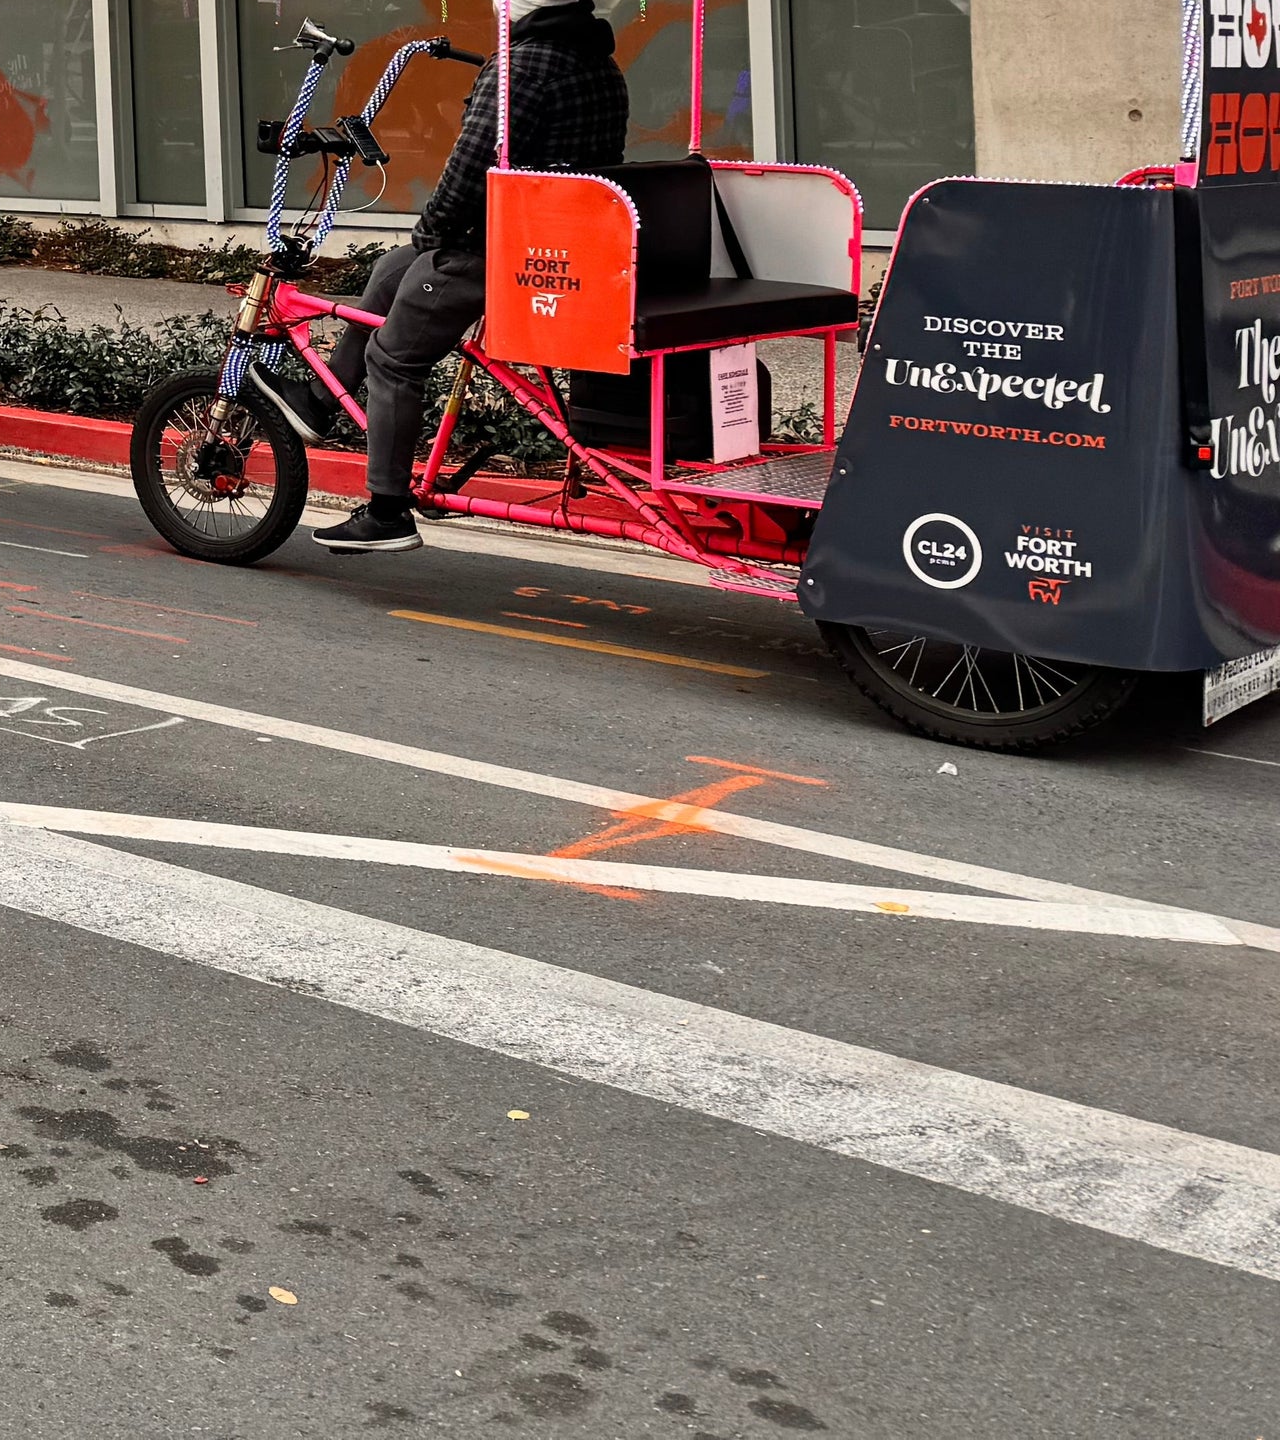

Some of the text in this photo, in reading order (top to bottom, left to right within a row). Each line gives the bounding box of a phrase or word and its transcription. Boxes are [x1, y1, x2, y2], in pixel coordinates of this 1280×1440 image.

[1205, 92, 1280, 176] HO
[527, 247, 569, 259] VISIT
[525, 258, 571, 274] FORT
[515, 272, 581, 291] WORTH
[1230, 278, 1259, 300] FORT
[924, 316, 1065, 341] DISCOVER
[963, 341, 1022, 361] THE
[885, 358, 1112, 414] UnExpected
[889, 414, 1107, 449] FORTWORTH.COM
[1021, 524, 1074, 538] VISIT
[917, 540, 968, 561] CL24
[1016, 535, 1077, 558] FORT
[1004, 551, 1092, 578] WORTH
